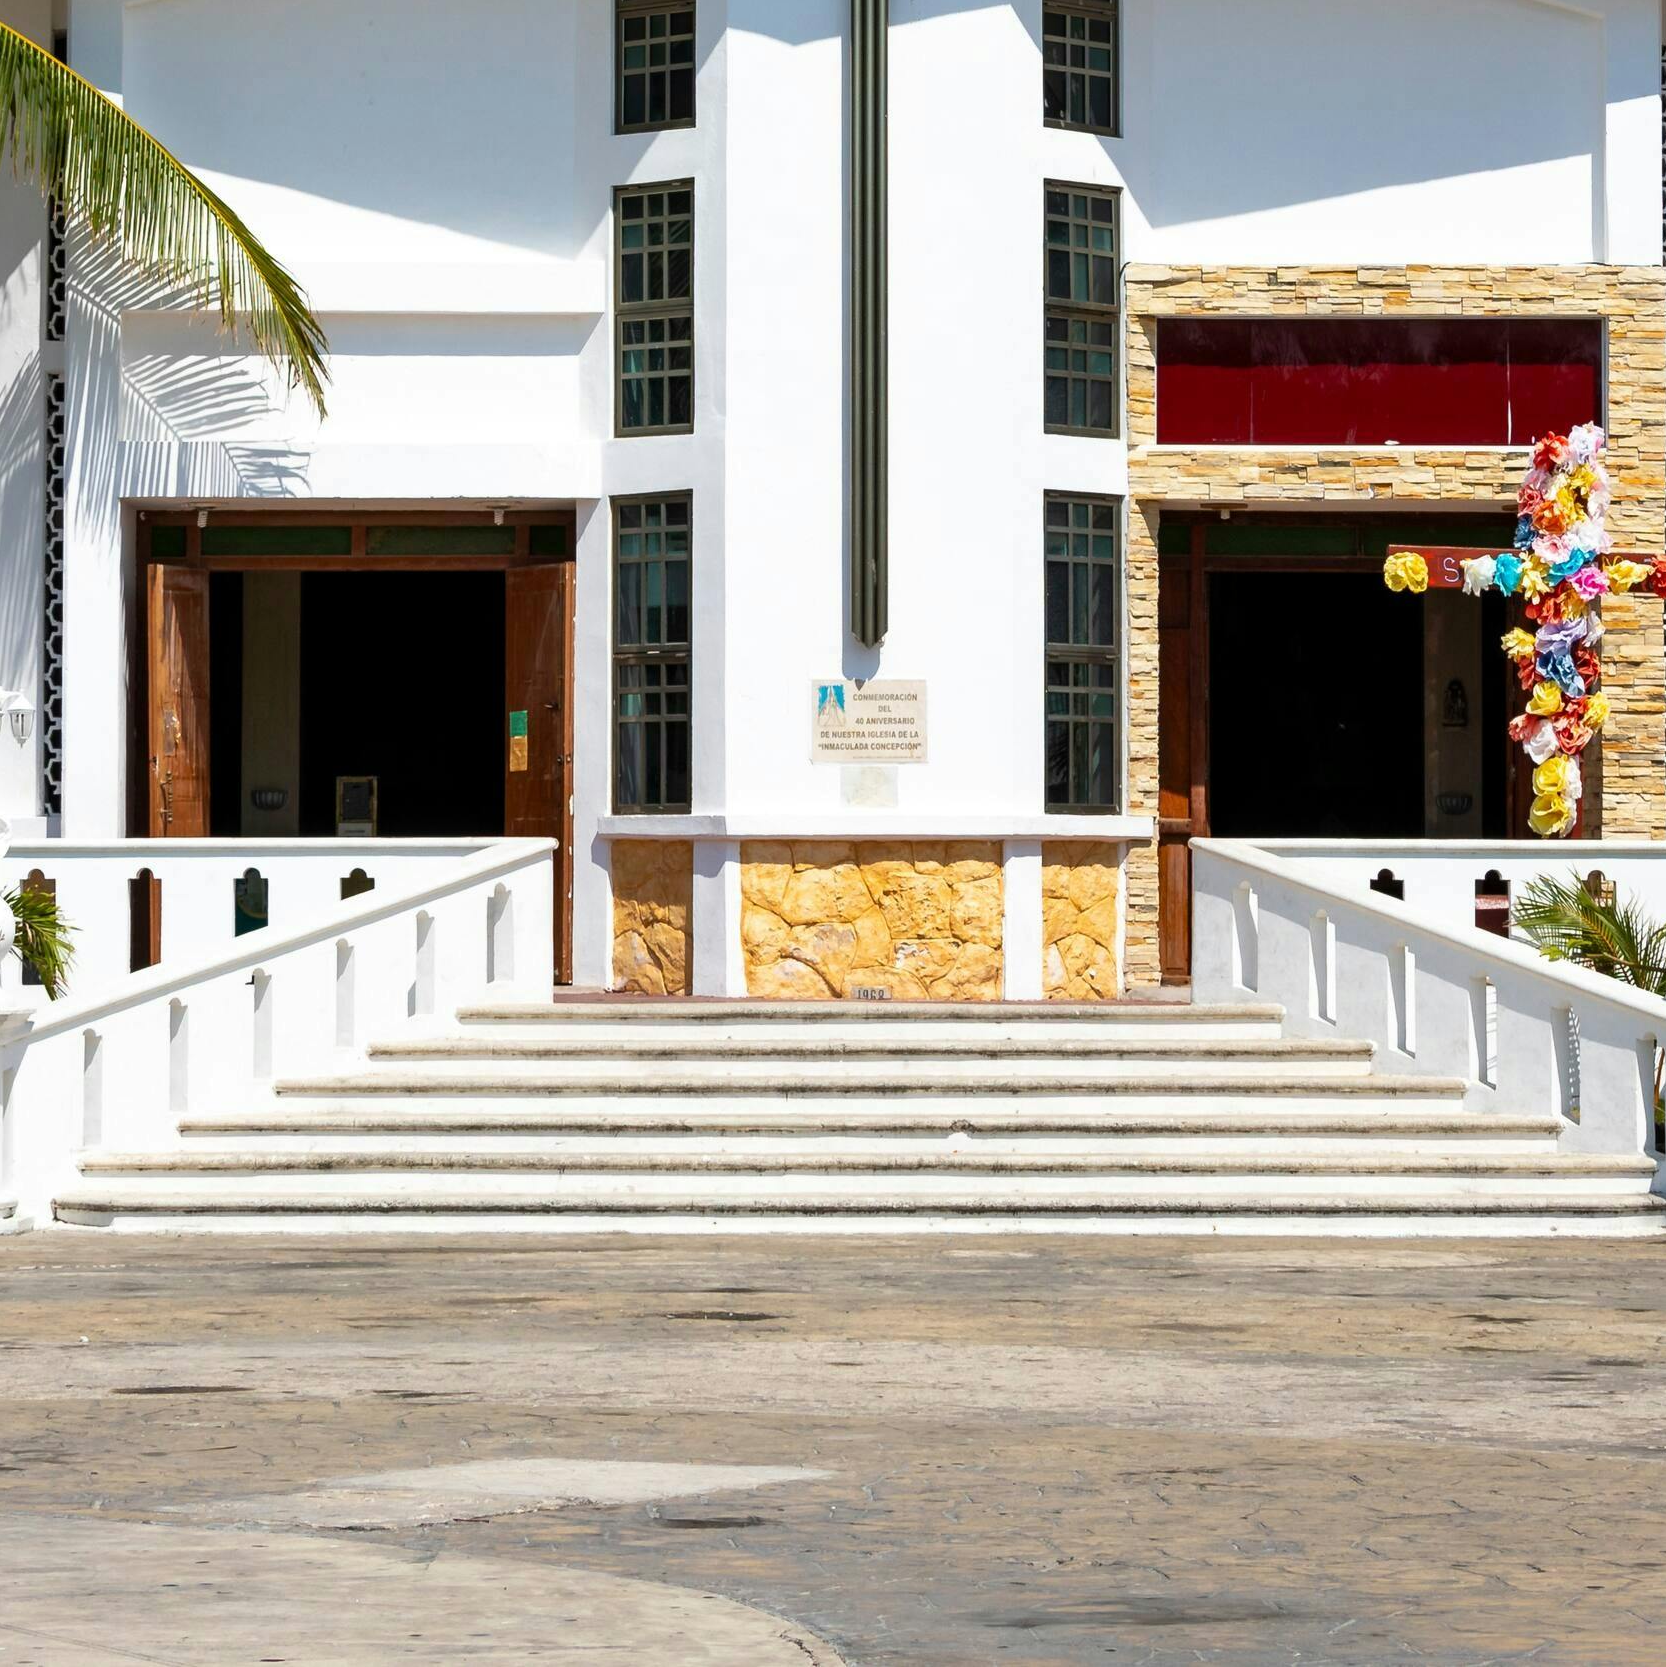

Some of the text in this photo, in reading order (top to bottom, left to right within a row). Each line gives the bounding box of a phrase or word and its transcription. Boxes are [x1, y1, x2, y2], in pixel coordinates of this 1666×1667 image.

[853, 693, 918, 701] CONMEMORACIÓN
[878, 705, 892, 713] DEL
[855, 717, 915, 725] 40 ANIVERSARIO
[820, 731, 919, 739] DE NUESTRA IGLESIA DE LA
